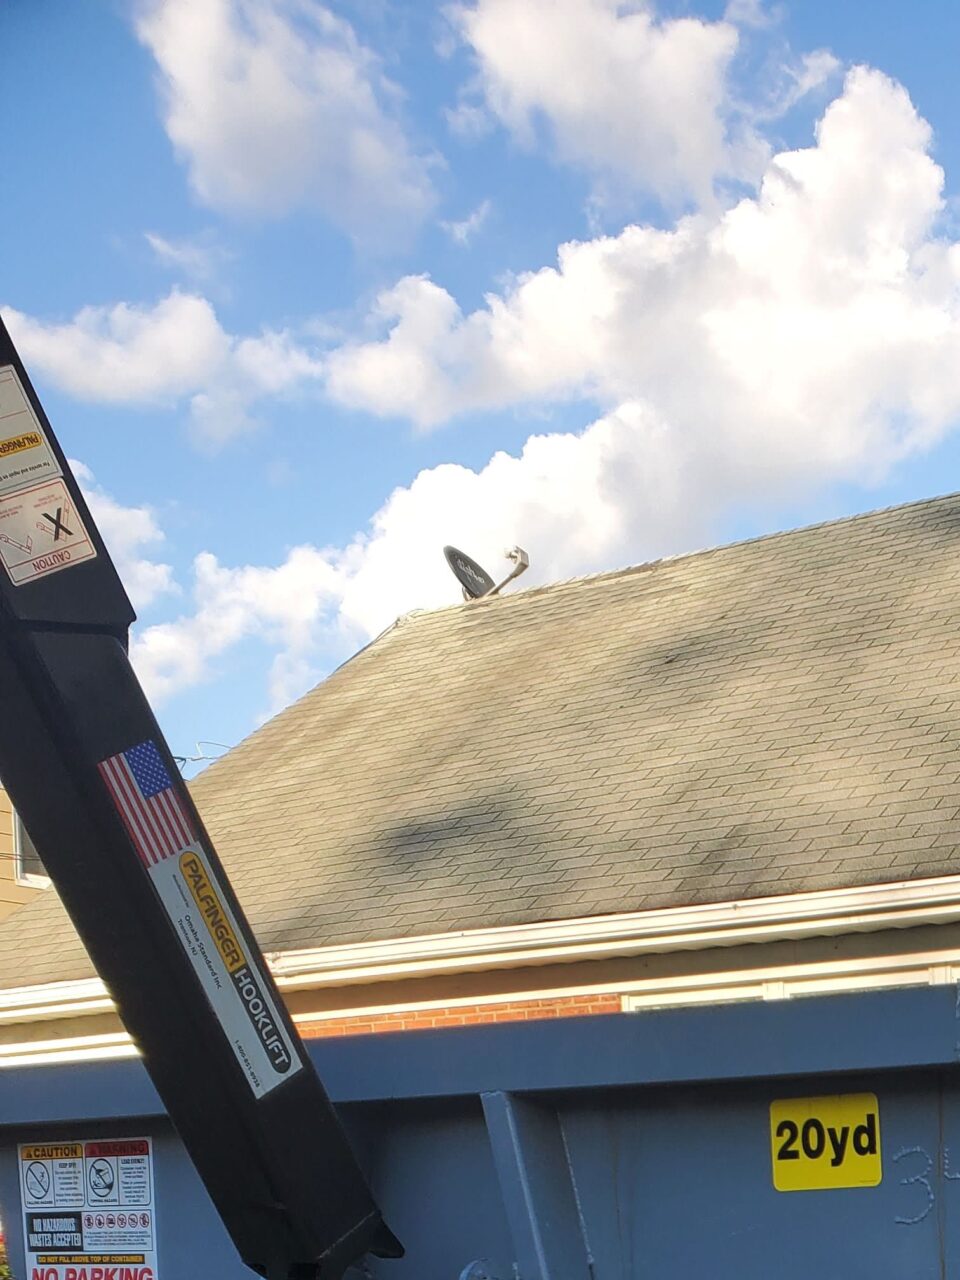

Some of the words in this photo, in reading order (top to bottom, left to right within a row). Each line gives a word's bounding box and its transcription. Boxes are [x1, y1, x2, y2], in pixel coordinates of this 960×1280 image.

[32, 550, 71, 572] CAUTION
[183, 857, 240, 968] PALFINGER
[233, 967, 288, 1066] HOOKLIFT
[184, 914, 200, 943] Omaha
[197, 942, 216, 977] Standard
[33, 1145, 78, 1158] CAUTION
[776, 1113, 878, 1167] 20yd
[52, 1232, 82, 1247] ACCEPTED
